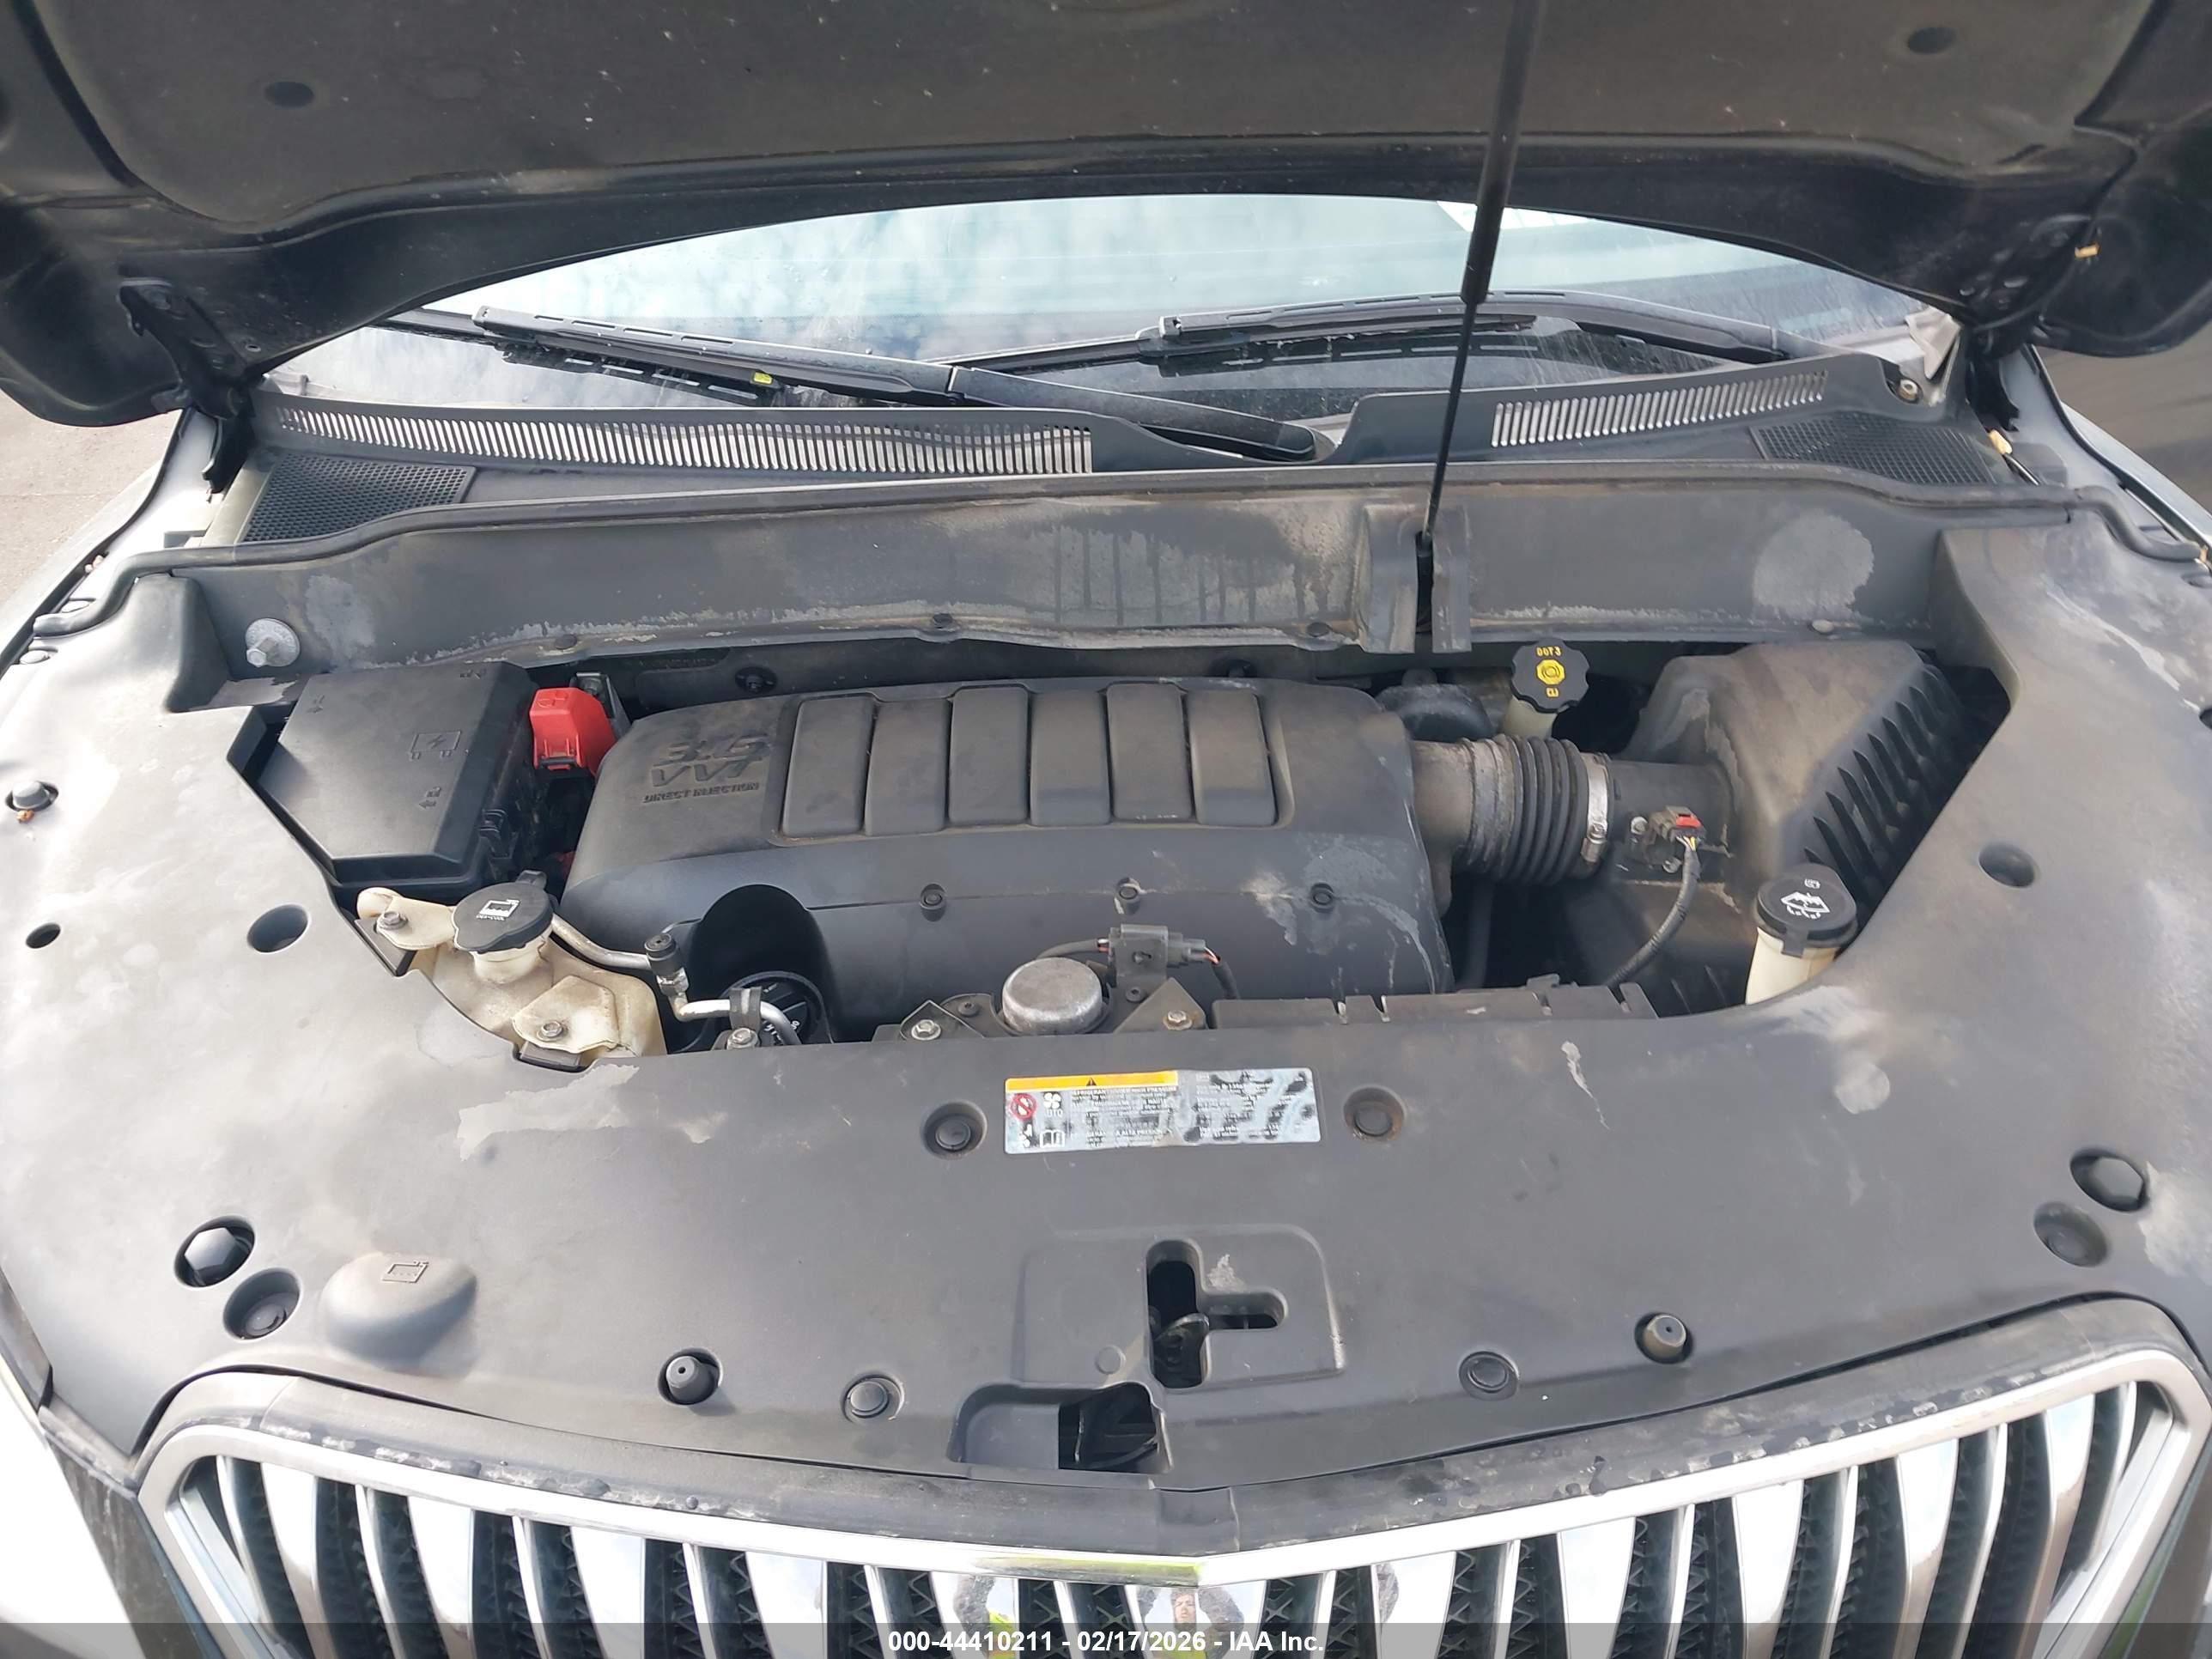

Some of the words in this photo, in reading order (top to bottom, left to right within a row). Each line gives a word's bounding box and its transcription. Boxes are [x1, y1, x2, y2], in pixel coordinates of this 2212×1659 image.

[651, 757, 762, 787] VVT
[642, 789, 691, 804] DIRECT
[693, 782, 759, 797] INJECTION
